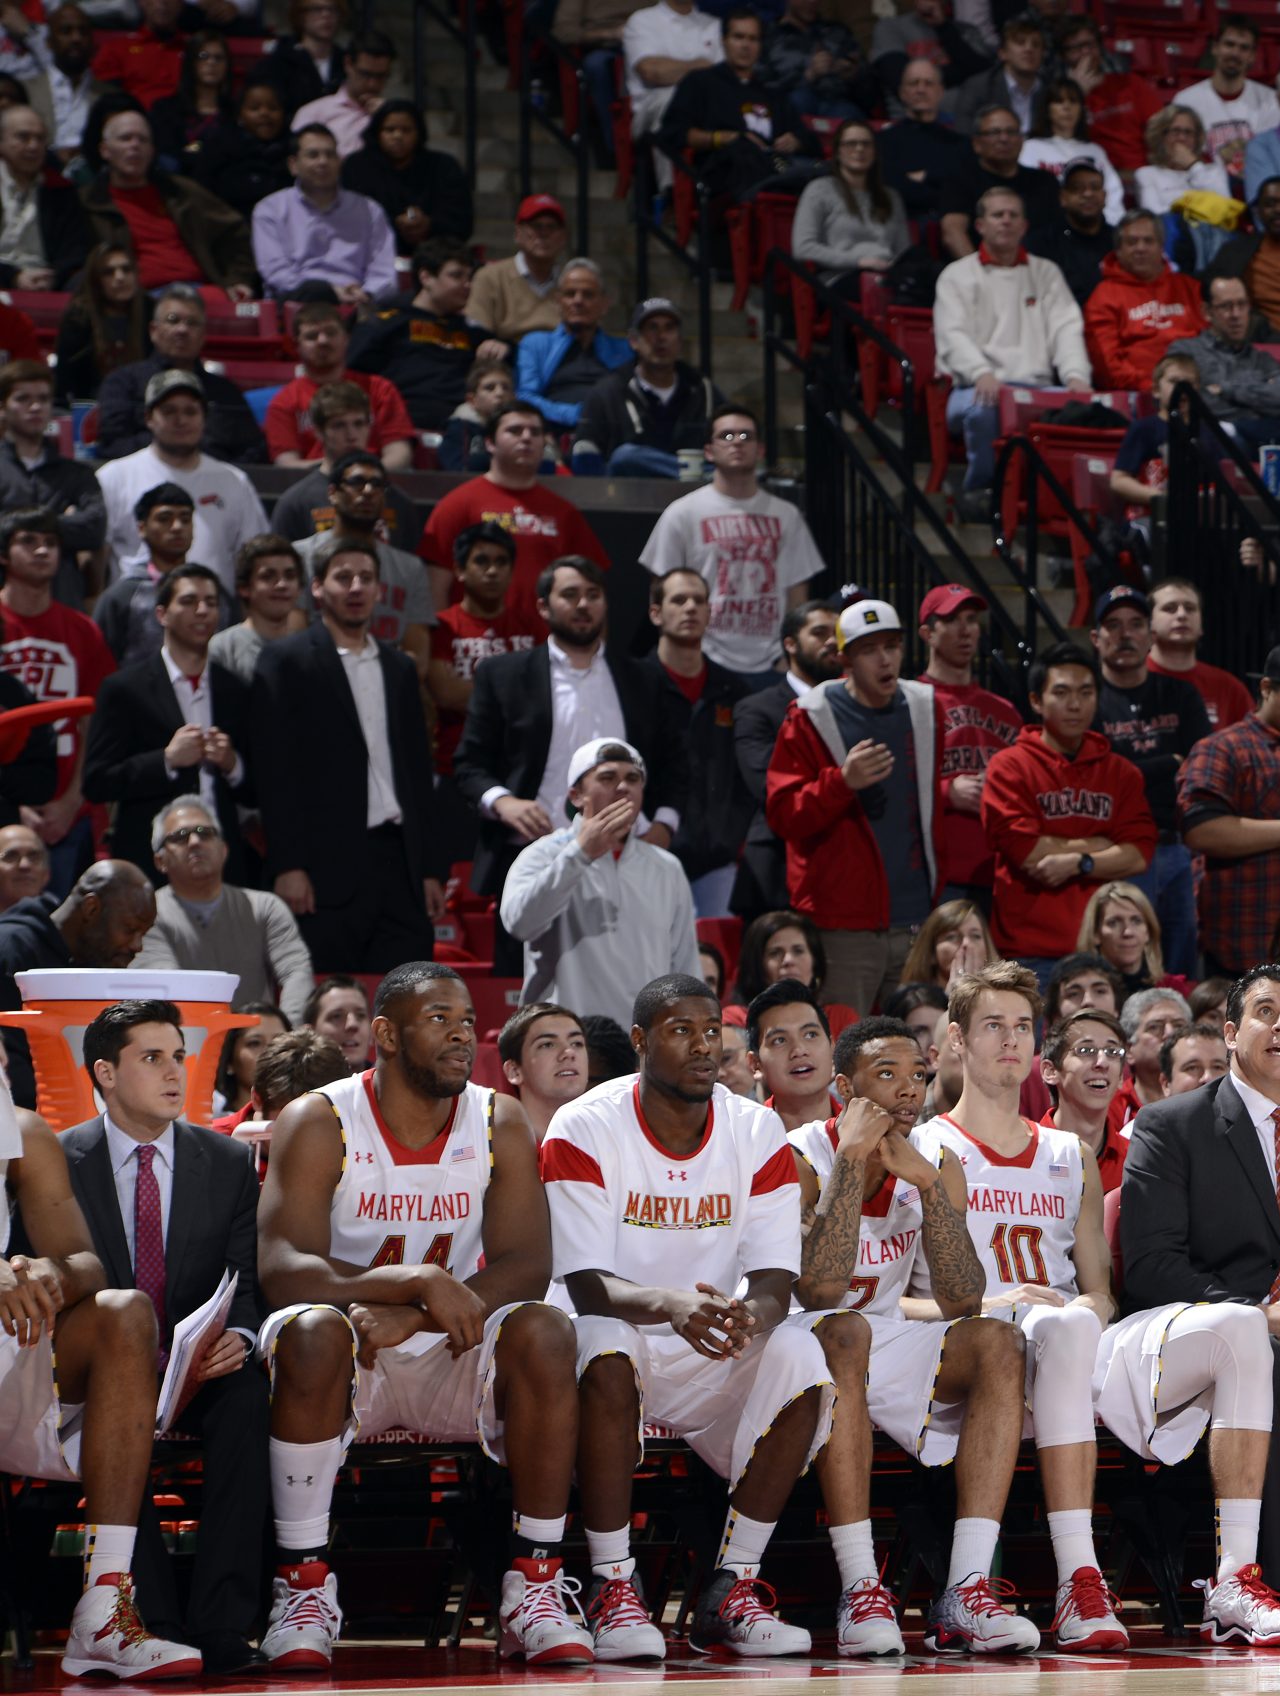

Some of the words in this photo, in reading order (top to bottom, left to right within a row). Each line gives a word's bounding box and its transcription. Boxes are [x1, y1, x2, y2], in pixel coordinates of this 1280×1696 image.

[355, 1191, 470, 1222] MARYLAND
[622, 1190, 733, 1223] MARYLAND
[966, 1188, 1066, 1220] MARYLAND
[368, 1232, 459, 1277] 44
[989, 1222, 1051, 1287] 10
[612, 1565, 623, 1576] M
[743, 1567, 754, 1578] M
